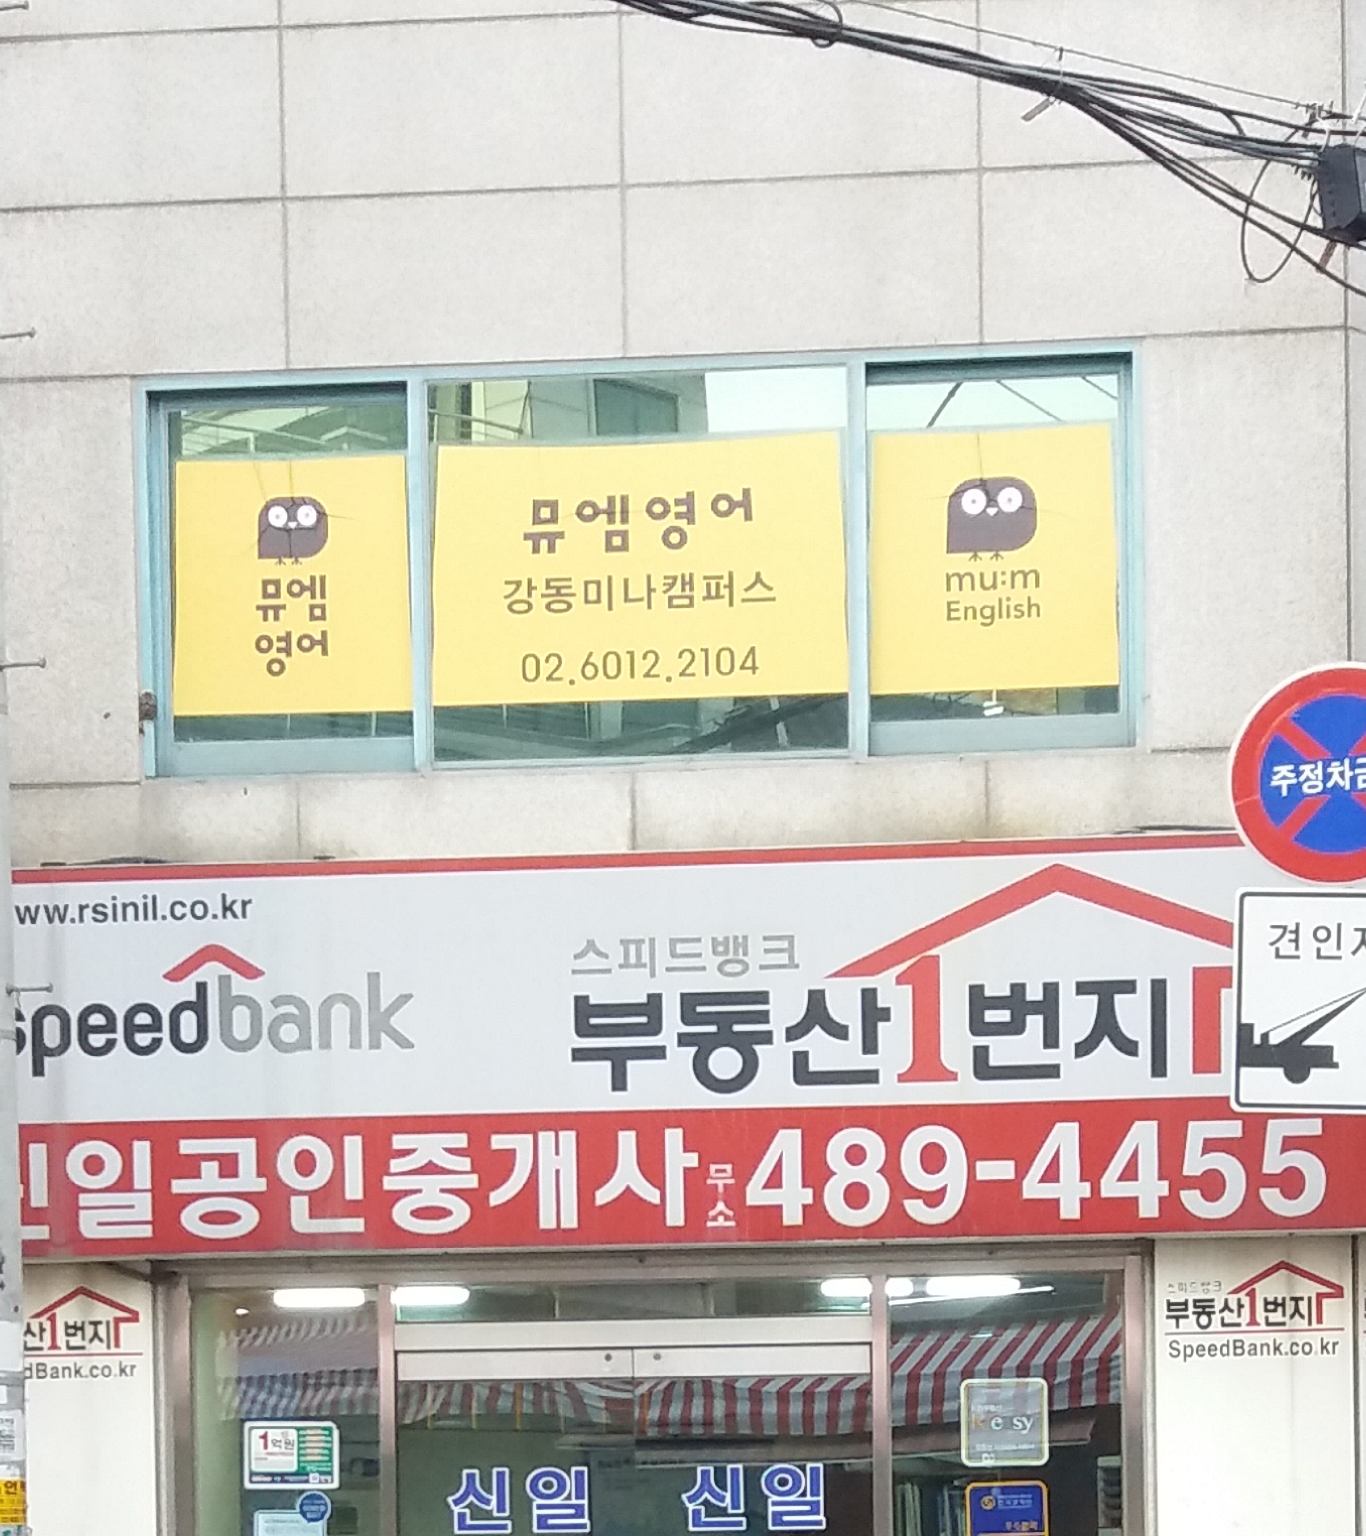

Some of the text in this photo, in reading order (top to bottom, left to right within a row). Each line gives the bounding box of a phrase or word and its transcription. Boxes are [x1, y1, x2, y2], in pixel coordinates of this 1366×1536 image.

[522, 487, 754, 554] 뮤엠영어
[255, 574, 328, 624] 뮤엠
[502, 570, 777, 615] 강동미나캠퍼스
[945, 565, 1041, 593] mu:m
[945, 597, 1041, 626] English
[254, 630, 329, 677] 영어
[521, 645, 760, 685] 02.6012.2104
[14, 892, 253, 927] ww.rsinil.co.kr
[571, 933, 800, 979] 스피드뱅크
[571, 954, 1168, 1094] 부동산1번지
[746, 1117, 1328, 1228] 489-4455
[23, 1312, 113, 1351] 산1번지
[1165, 1288, 1313, 1329] 부동산1번지
[447, 1466, 591, 1535] 신일
[681, 1462, 826, 1531] 신일
